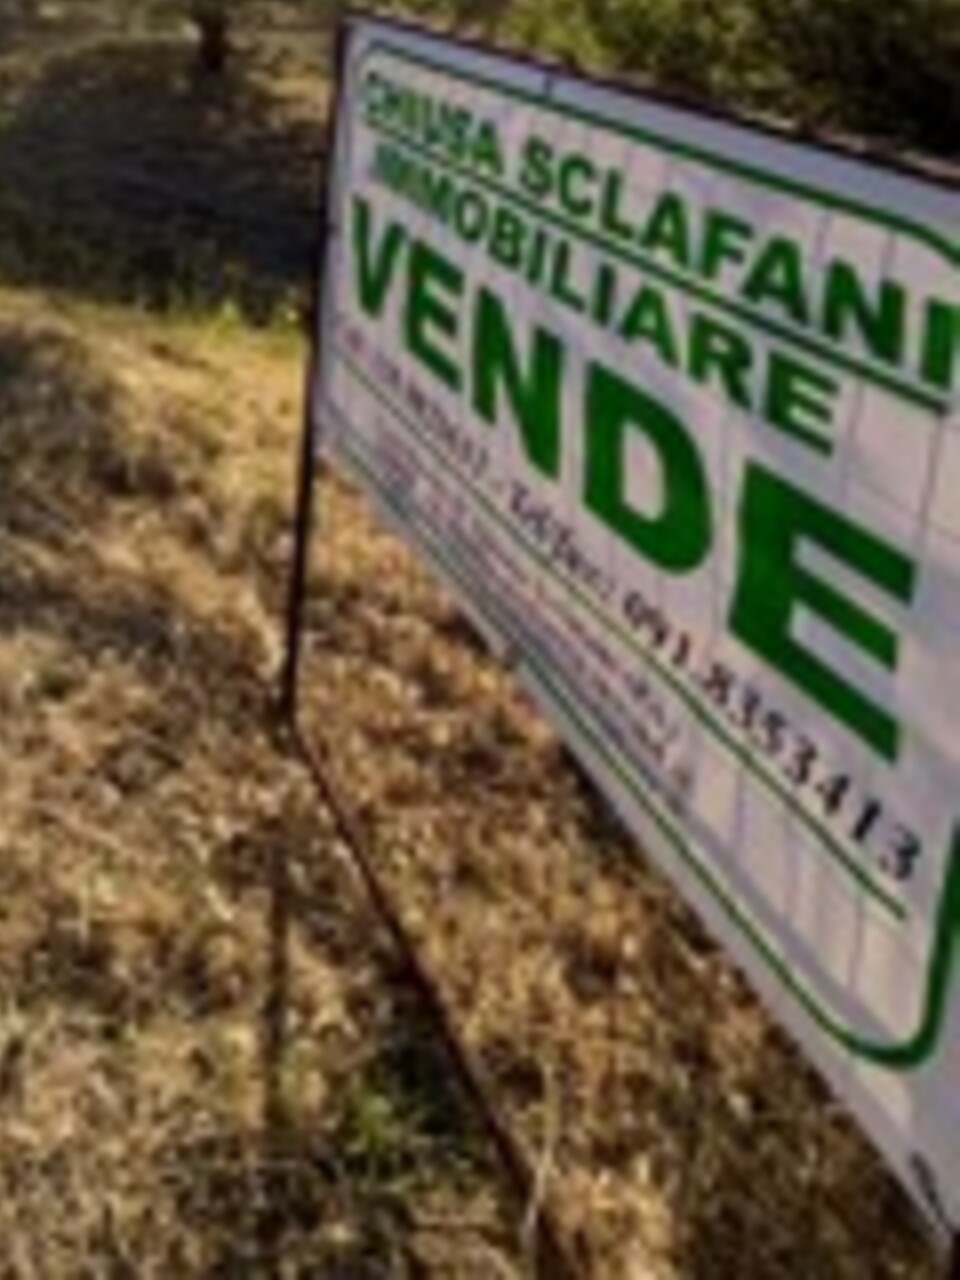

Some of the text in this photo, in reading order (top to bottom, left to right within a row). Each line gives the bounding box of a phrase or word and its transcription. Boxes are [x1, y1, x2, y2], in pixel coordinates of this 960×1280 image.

[376, 143, 837, 456] IMMOBILIARE
[520, 136, 960, 388] SCLAFANI
[352, 195, 914, 761] VENDE
